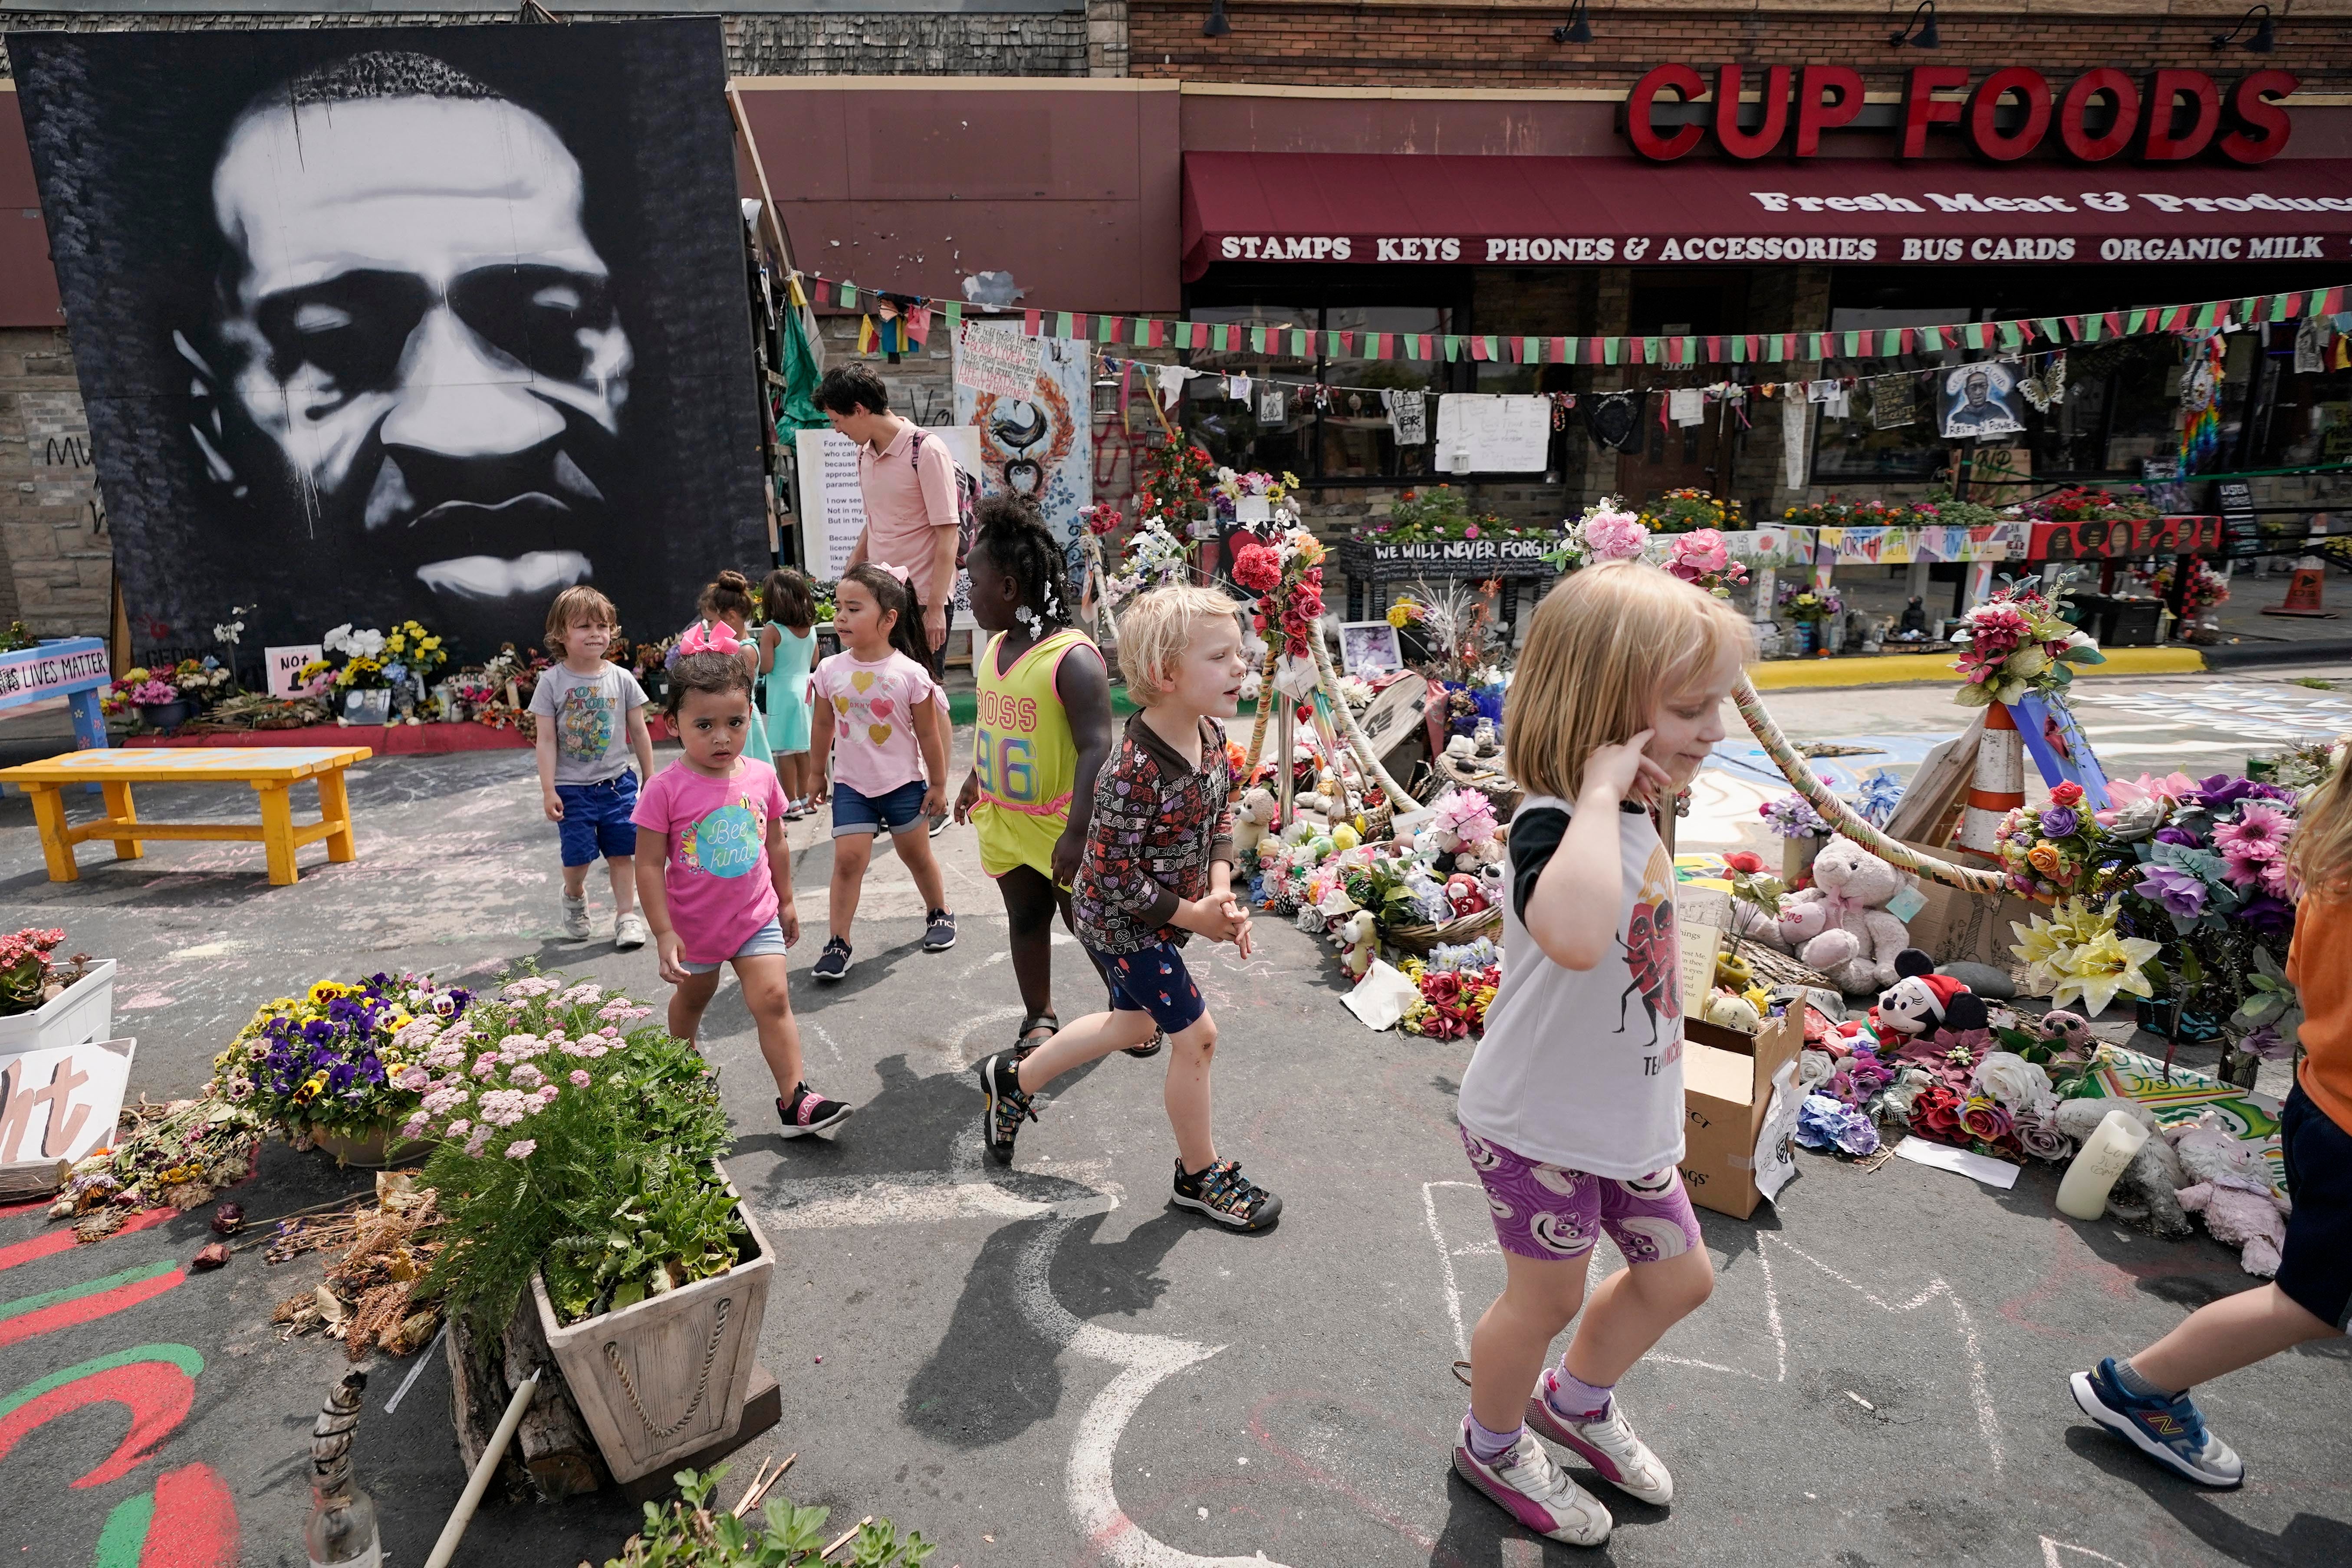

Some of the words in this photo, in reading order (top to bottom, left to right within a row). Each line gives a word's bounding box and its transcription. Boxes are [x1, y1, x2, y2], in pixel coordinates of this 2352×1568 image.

[1628, 63, 1865, 160] CUP
[1903, 66, 2300, 163] FOODS
[1749, 192, 1926, 212] Fresh
[1924, 193, 2078, 212] Meat
[2080, 192, 2129, 212] &
[2137, 193, 2352, 212] Produc
[1221, 237, 1351, 260] STAMPS
[1377, 237, 1460, 261] KEYS
[1486, 238, 1614, 261] PHONES
[1623, 237, 1650, 260] &
[1658, 237, 1877, 261] ACCESSORIES
[1901, 239, 1963, 261] BUS
[1971, 238, 2075, 260] CARDS
[2101, 238, 2241, 260] ORGANIC
[2248, 237, 2323, 259] MILK
[983, 326, 995, 337] hold
[996, 329, 1014, 342] these
[1375, 545, 1398, 559] WE
[1402, 544, 1441, 559] WILL
[1443, 542, 1497, 560] NEVER
[22, 661, 58, 688] LIVES
[61, 652, 106, 680] MATTER
[565, 686, 601, 698] TOY
[565, 697, 618, 710] STORY
[977, 687, 1037, 732] BOSS
[977, 728, 1039, 801] 96
[707, 819, 749, 845] Bee
[711, 841, 752, 869] kind
[1688, 959, 1704, 967] thee.
[1695, 951, 1707, 960] Me,
